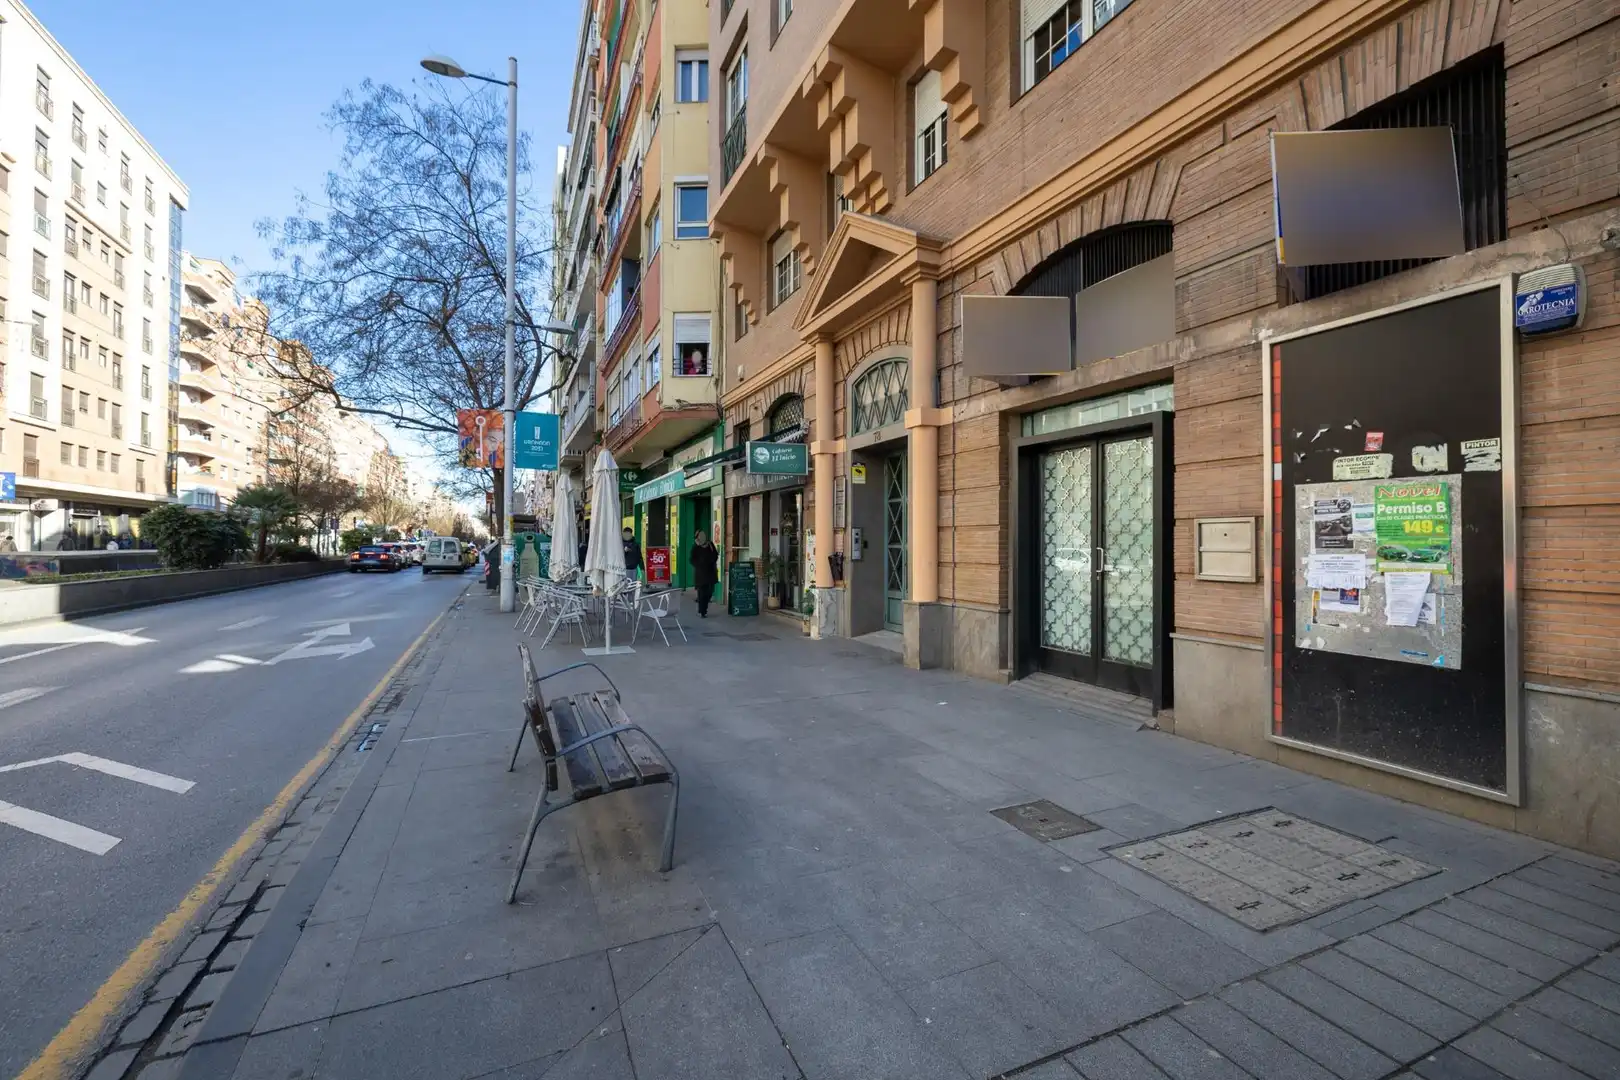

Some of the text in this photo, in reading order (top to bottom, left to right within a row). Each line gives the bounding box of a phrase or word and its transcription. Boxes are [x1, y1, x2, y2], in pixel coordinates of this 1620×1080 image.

[1466, 440, 1497, 448] PINTOR
[1377, 484, 1441, 499] Novel
[1377, 502, 1447, 514] Permiso B
[1404, 520, 1433, 534] 149
